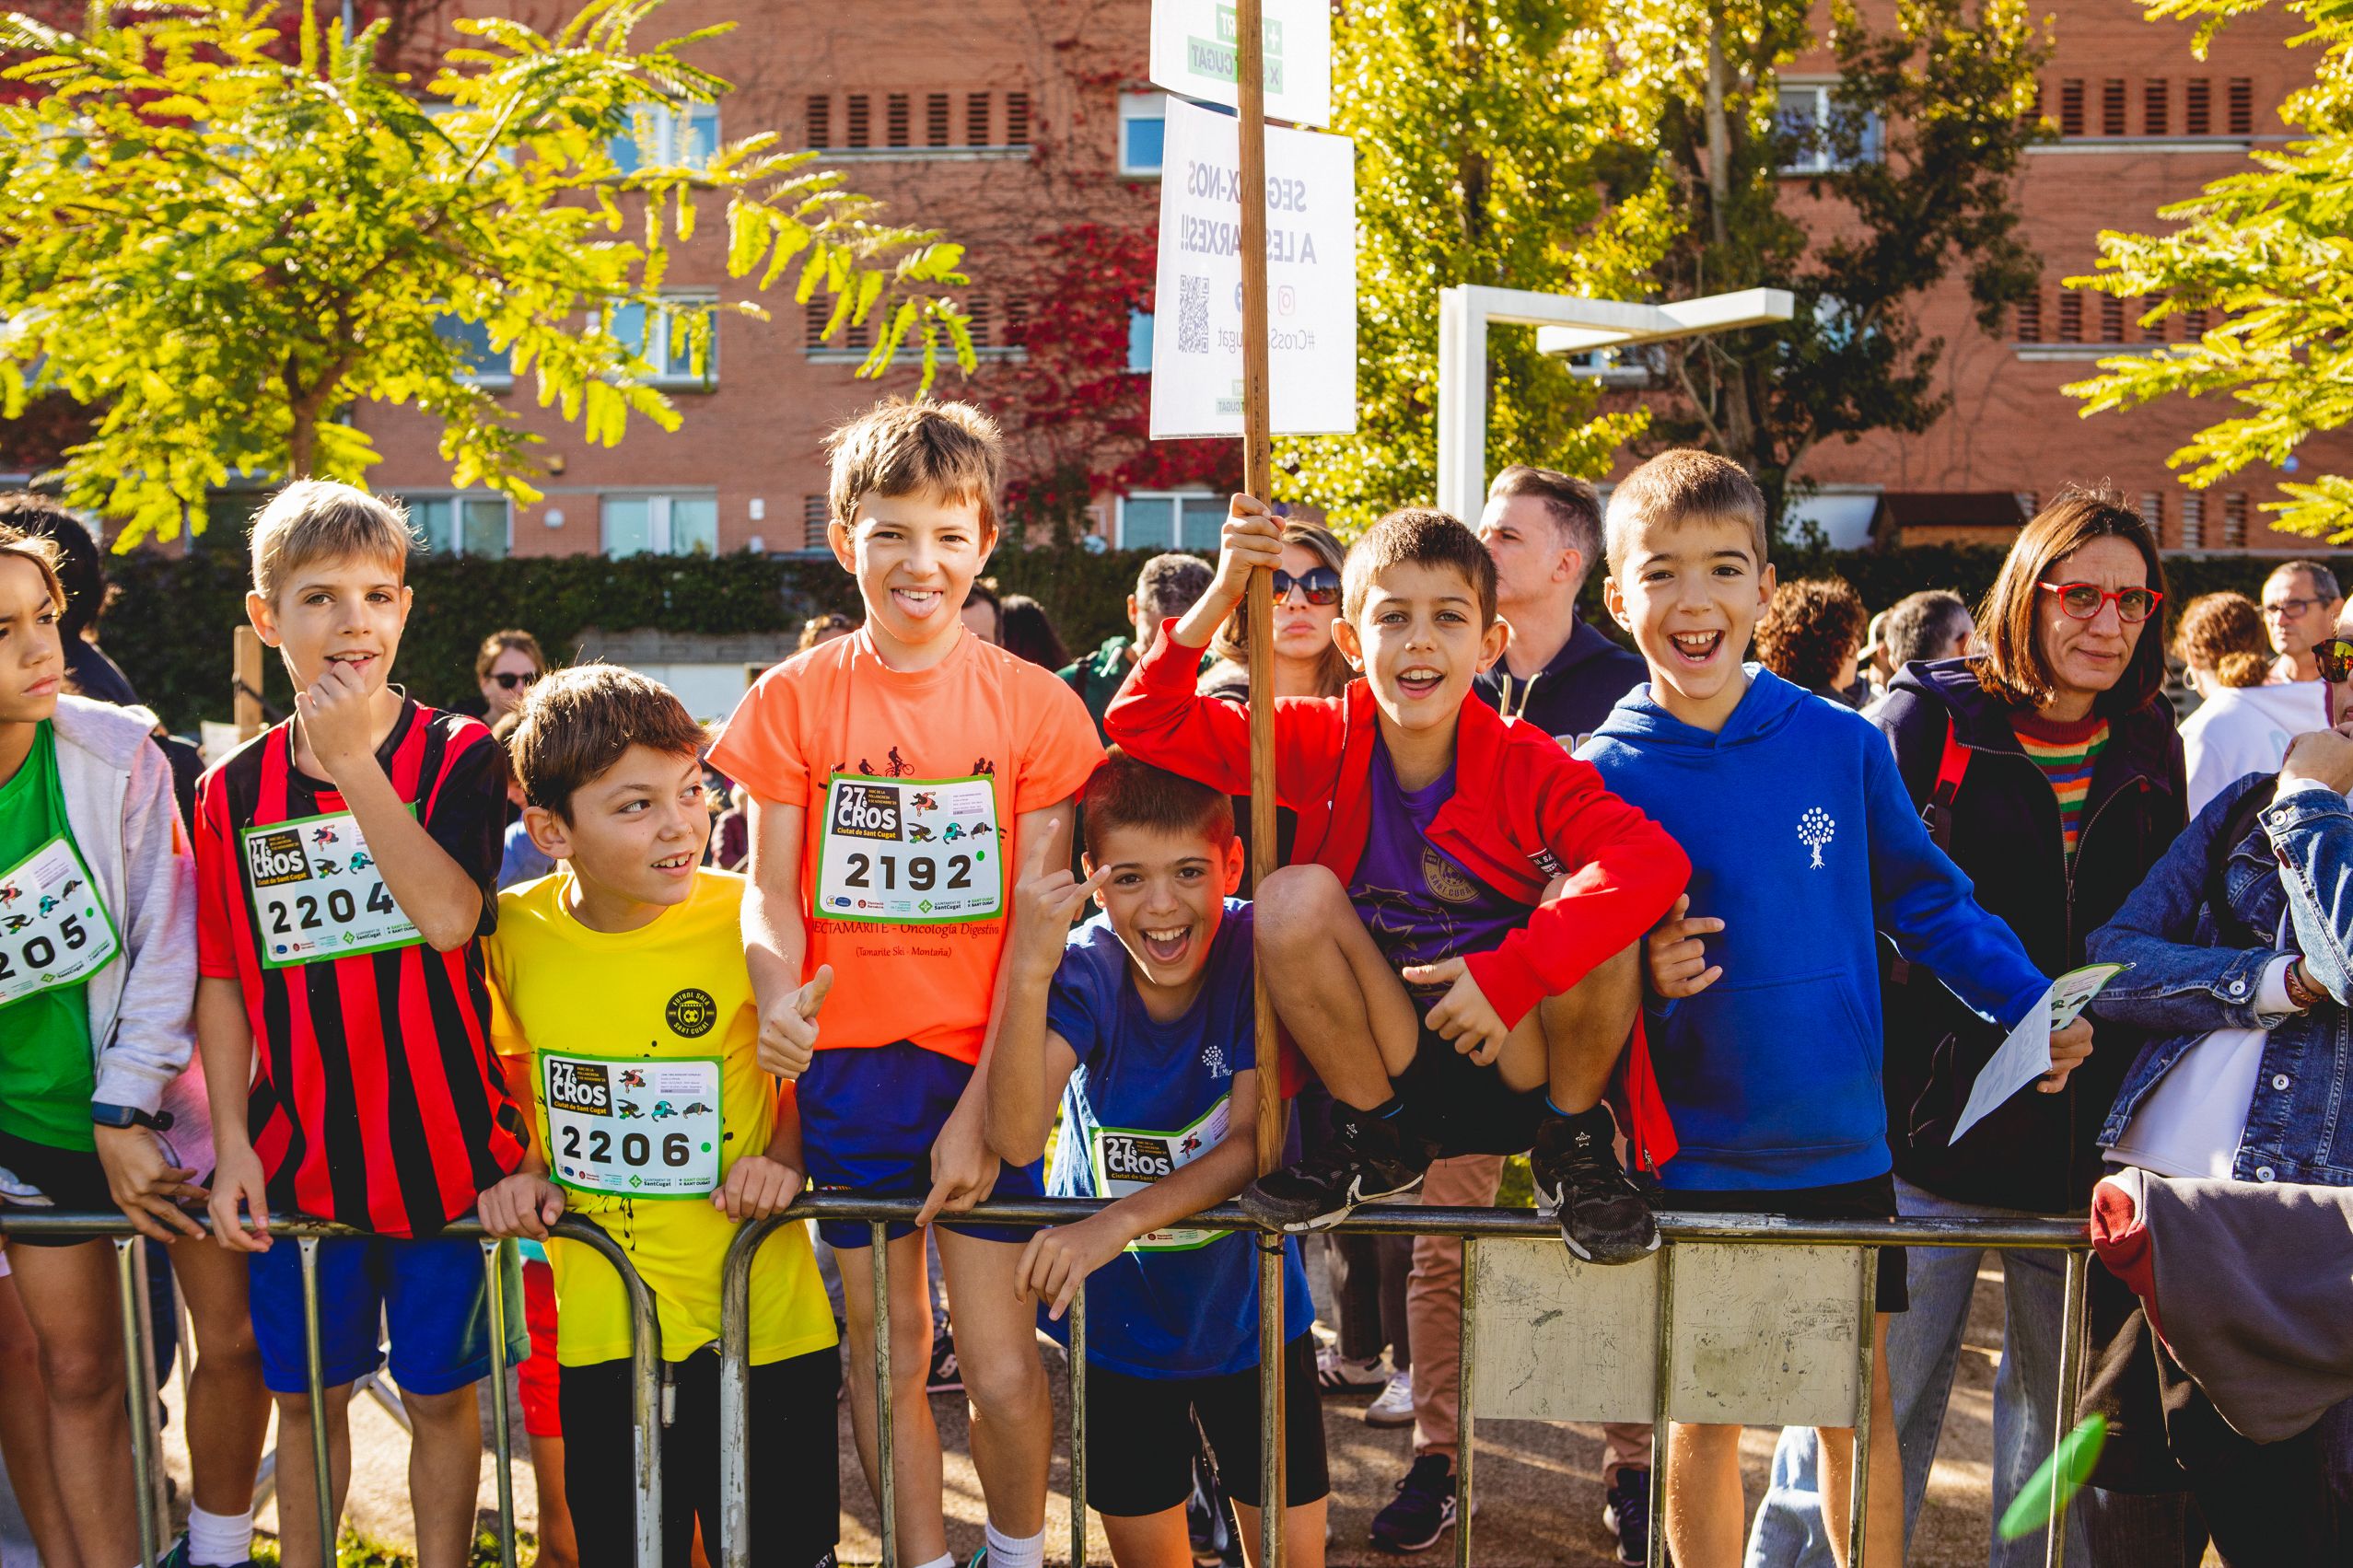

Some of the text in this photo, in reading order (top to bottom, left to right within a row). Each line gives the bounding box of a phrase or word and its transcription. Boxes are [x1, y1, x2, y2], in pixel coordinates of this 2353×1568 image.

[837, 806, 897, 830] CROS
[252, 850, 305, 878] CROS
[845, 853, 972, 890] 2192
[268, 881, 394, 935] 2204
[856, 947, 891, 957] (Tamarite
[892, 946, 905, 956] Ski
[911, 946, 952, 958] Montaña)
[695, 993, 711, 1006] SALA
[673, 1021, 709, 1035] SANT CUGAT
[553, 1081, 607, 1107] CROS
[553, 1100, 569, 1109] Ciutat
[589, 1107, 607, 1115] Cugat
[562, 1125, 690, 1167] 2206
[1108, 1155, 1171, 1176] CROS
